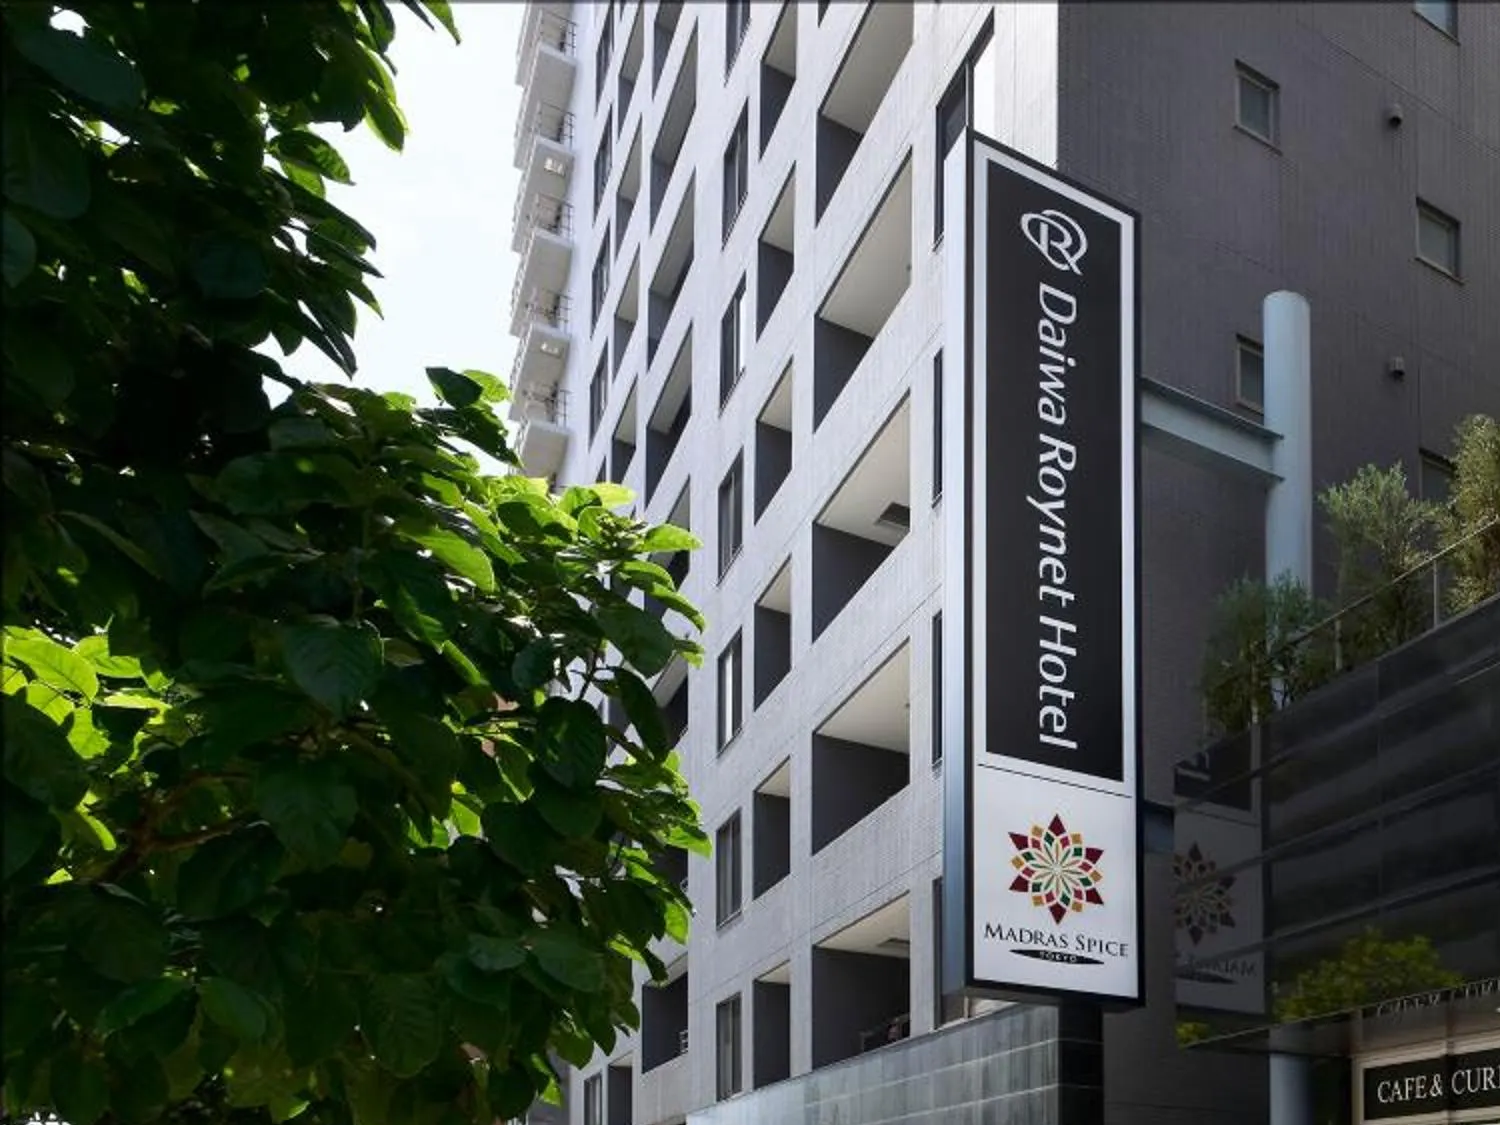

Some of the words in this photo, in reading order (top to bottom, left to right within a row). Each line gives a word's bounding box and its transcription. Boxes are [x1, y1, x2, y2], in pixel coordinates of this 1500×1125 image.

[1037, 282, 1077, 424] Daiwa
[1026, 431, 1077, 605] Roynet
[1038, 606, 1077, 752] Hotel
[984, 922, 1069, 949] MADRAS
[1075, 934, 1129, 957] SPICE
[1039, 951, 1078, 963] TOKYO
